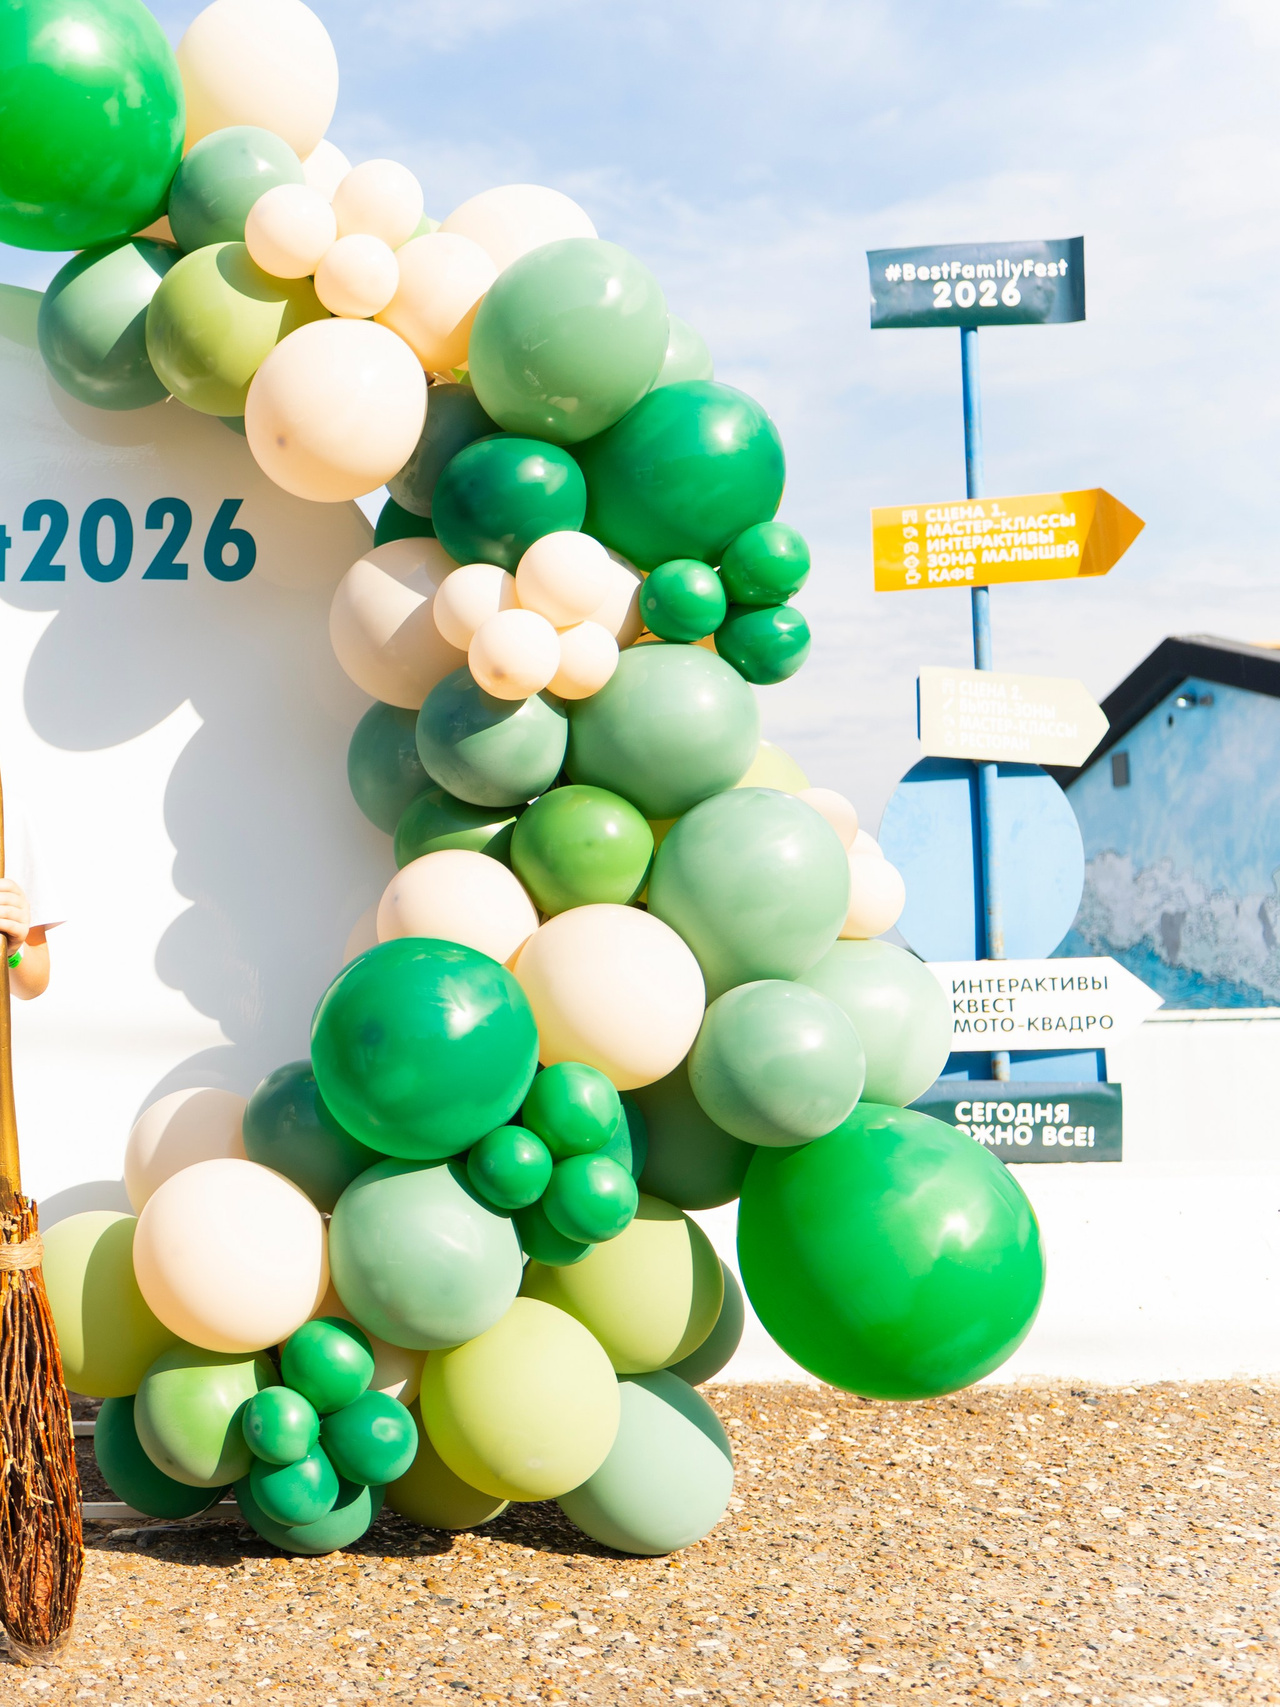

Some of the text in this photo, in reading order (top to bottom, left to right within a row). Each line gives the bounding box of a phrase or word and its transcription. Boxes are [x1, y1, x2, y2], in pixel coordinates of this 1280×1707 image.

[885, 258, 1068, 282] #BestFamilyFest
[932, 280, 1022, 308] 2026
[925, 503, 1006, 524] СЦЕНА 1.
[926, 513, 1076, 538] МАСТЕР-КЛАССЫ
[926, 530, 1055, 552] ИНТЕРАКТИВЫ
[927, 540, 1080, 568] ЗОНА МАЛЫШЕЙ
[928, 566, 975, 583] КАФЕ
[959, 680, 1007, 699] СЦЕНА
[959, 697, 1057, 719] БЬЮТИ-ЗОНЫ
[959, 714, 1079, 739] МАСТЕР-КЛАССЫ
[959, 731, 1031, 751] РЕСТОРАН
[952, 976, 1109, 994] ИНТЕРАКТИВЫ
[953, 998, 1016, 1014] КВЕСТ
[953, 1015, 1114, 1034] МОТО-КВАДРО
[954, 1101, 1070, 1126] СЕГОДНЯ
[1042, 1125, 1096, 1147] ВСЕ!
